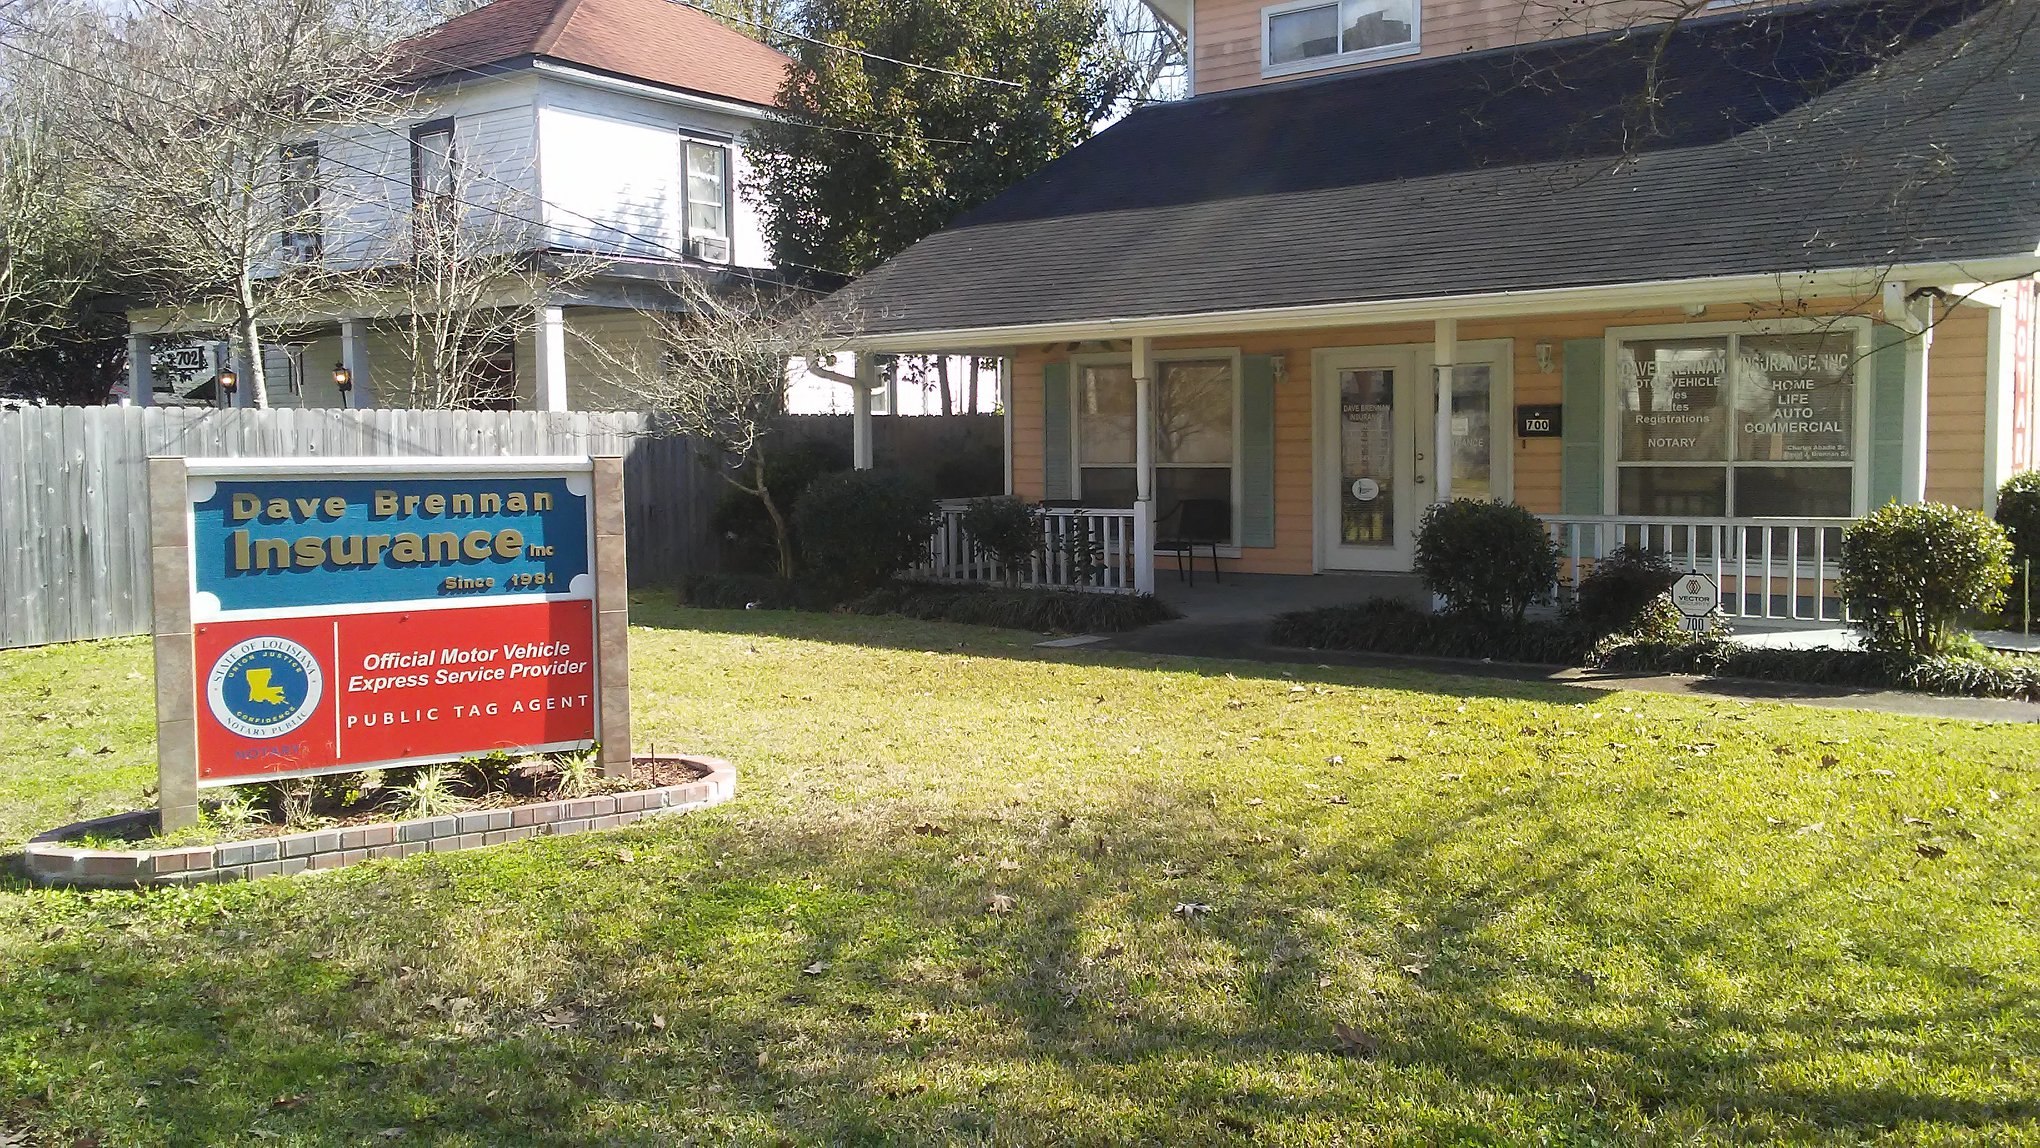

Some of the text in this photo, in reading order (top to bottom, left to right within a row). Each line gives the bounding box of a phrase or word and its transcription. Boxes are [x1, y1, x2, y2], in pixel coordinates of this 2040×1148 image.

[176, 351, 199, 365] 702
[1621, 361, 1655, 376] DAVE
[1825, 353, 1849, 369] INC
[1671, 377, 1721, 388] VEHICLE
[1772, 379, 1815, 391] HOME
[2014, 289, 2028, 472] NOTAR
[1778, 394, 1809, 405] LIFE
[1343, 404, 1360, 413] DAVE
[1773, 407, 1814, 419] AUTO
[1527, 420, 1549, 430] 700
[1635, 414, 1711, 426] Registrations
[1744, 421, 1843, 433] COMMERCIAL
[1648, 438, 1696, 448] NOTARY
[232, 489, 554, 520] Dave Brennan
[234, 527, 555, 570] Insurance Inc
[445, 571, 554, 590] Since 1981
[1685, 617, 1704, 631] 700
[213, 640, 317, 682] STATE OF LOUISIANA
[228, 651, 303, 678] UNION JUSTICE
[362, 641, 571, 672] Official Motor Vehicle
[347, 659, 588, 694] Express Service Provider
[236, 706, 297, 723] CONFIDENCE
[347, 694, 589, 729] PUBLIC TAG AGENT
[226, 711, 309, 736] NOTARY PUBLIC
